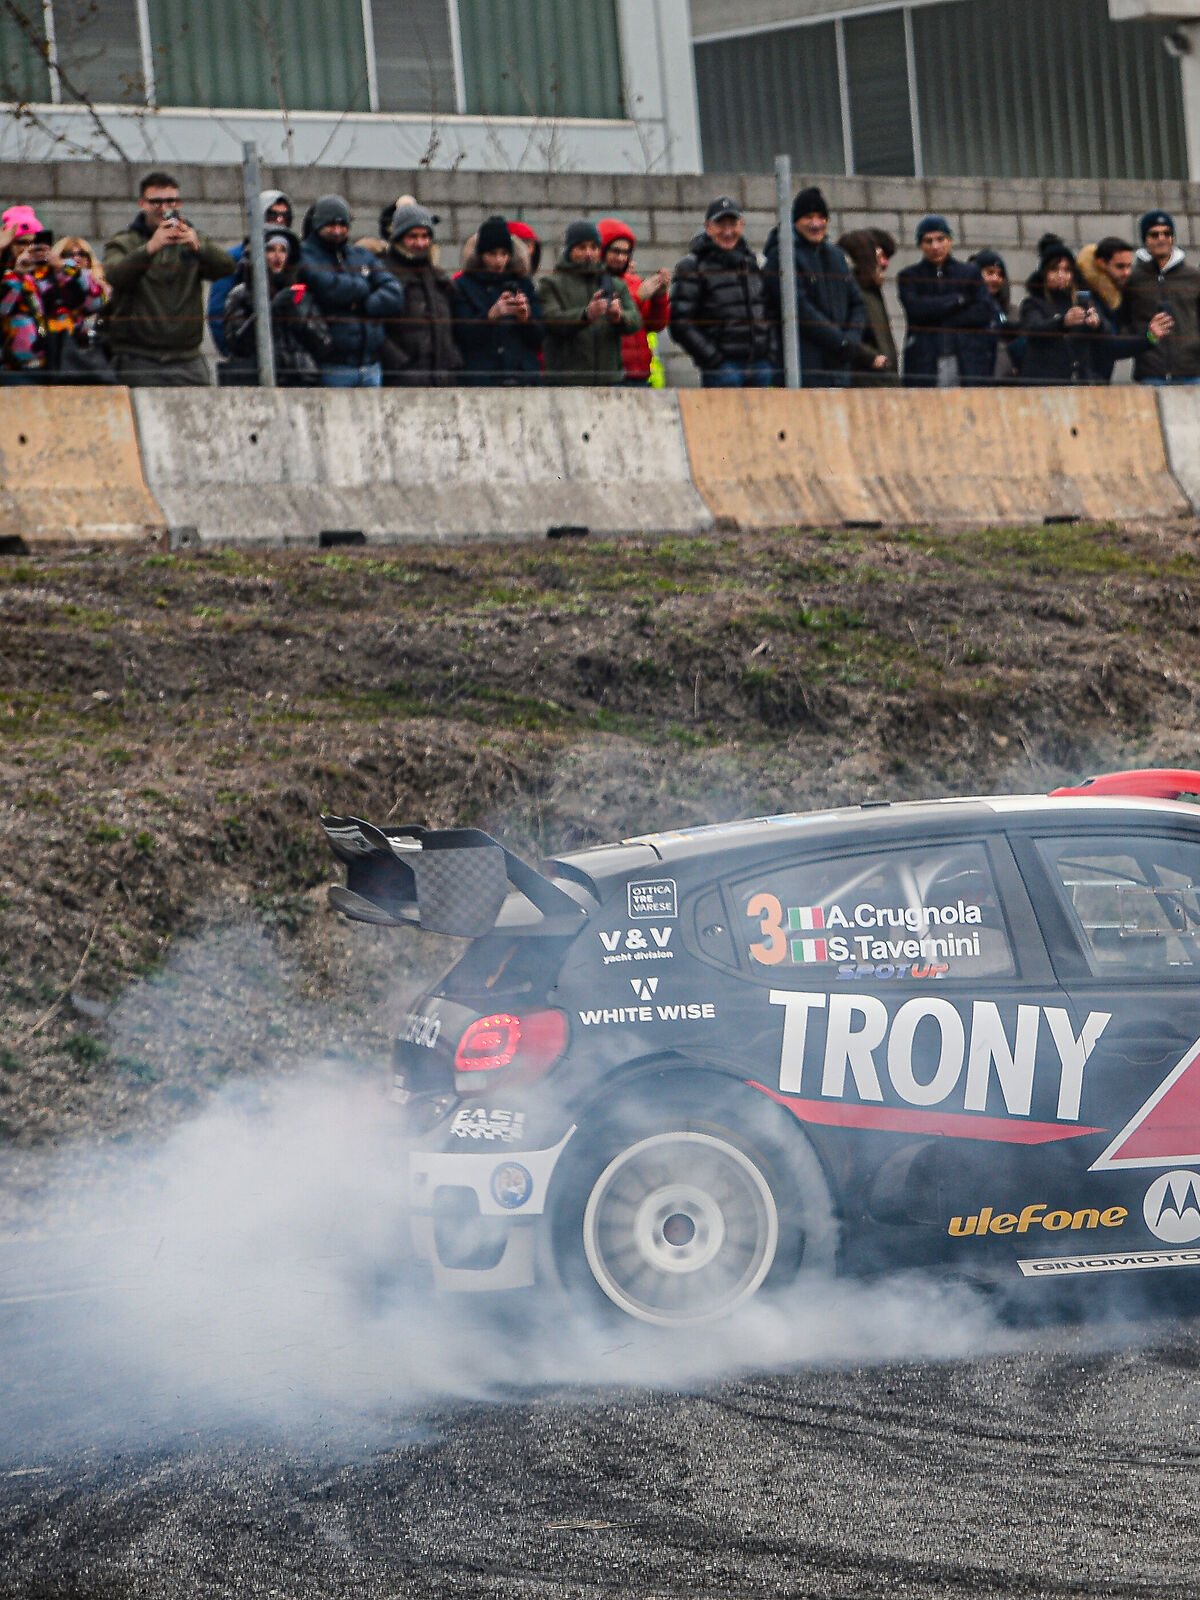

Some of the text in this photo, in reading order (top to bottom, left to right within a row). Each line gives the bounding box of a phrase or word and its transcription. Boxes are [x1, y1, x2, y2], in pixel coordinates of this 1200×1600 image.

[632, 886, 672, 896] OTTICA
[632, 895, 654, 903] TRE
[633, 902, 673, 912] VARESE
[826, 900, 982, 932] A.Crugnola
[599, 926, 672, 951] V & V
[746, 893, 787, 966] 3
[603, 950, 674, 965] yacht division
[828, 932, 981, 962] S.Tavernini
[579, 1003, 716, 1026] WHITE WISE
[769, 989, 1112, 1121] TRONY
